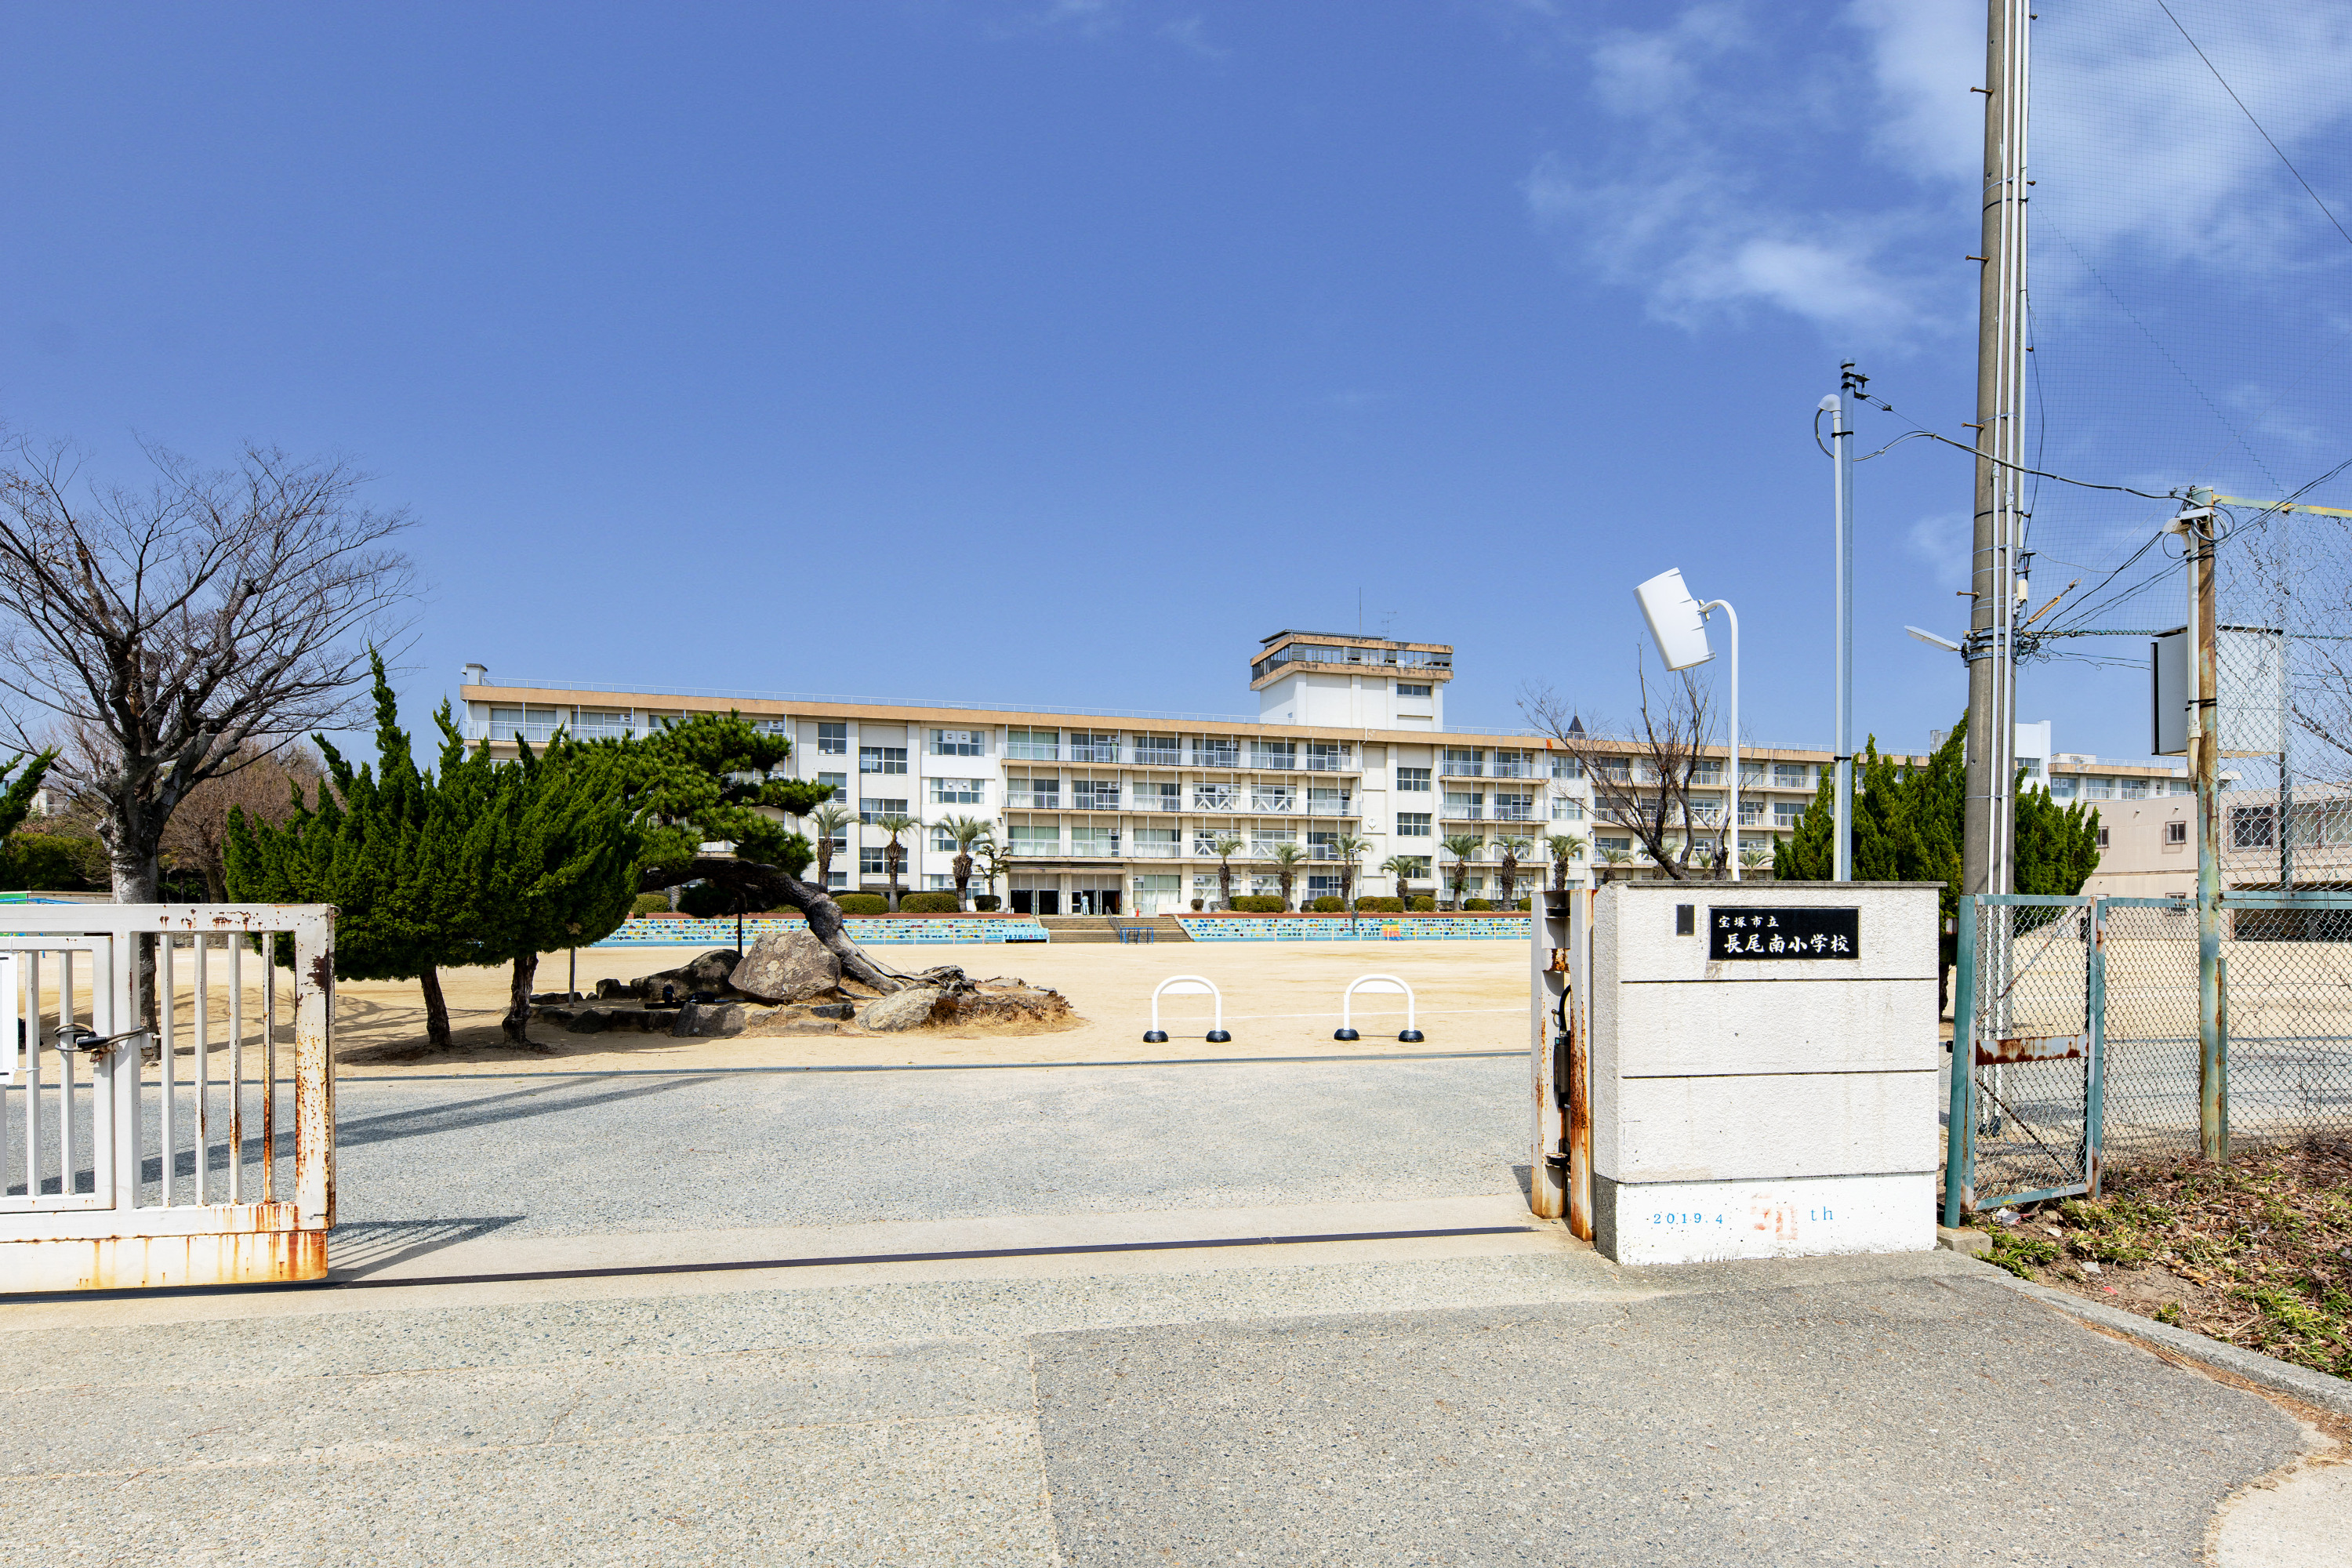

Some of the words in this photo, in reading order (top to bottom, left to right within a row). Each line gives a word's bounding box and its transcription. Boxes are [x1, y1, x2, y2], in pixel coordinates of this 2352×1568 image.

[1718, 915, 1780, 928] 宝塚市立
[1723, 933, 1850, 953] 長尾南小学校
[1653, 1213, 1723, 1224] 2019.4
[1810, 1206, 1834, 1221] th
